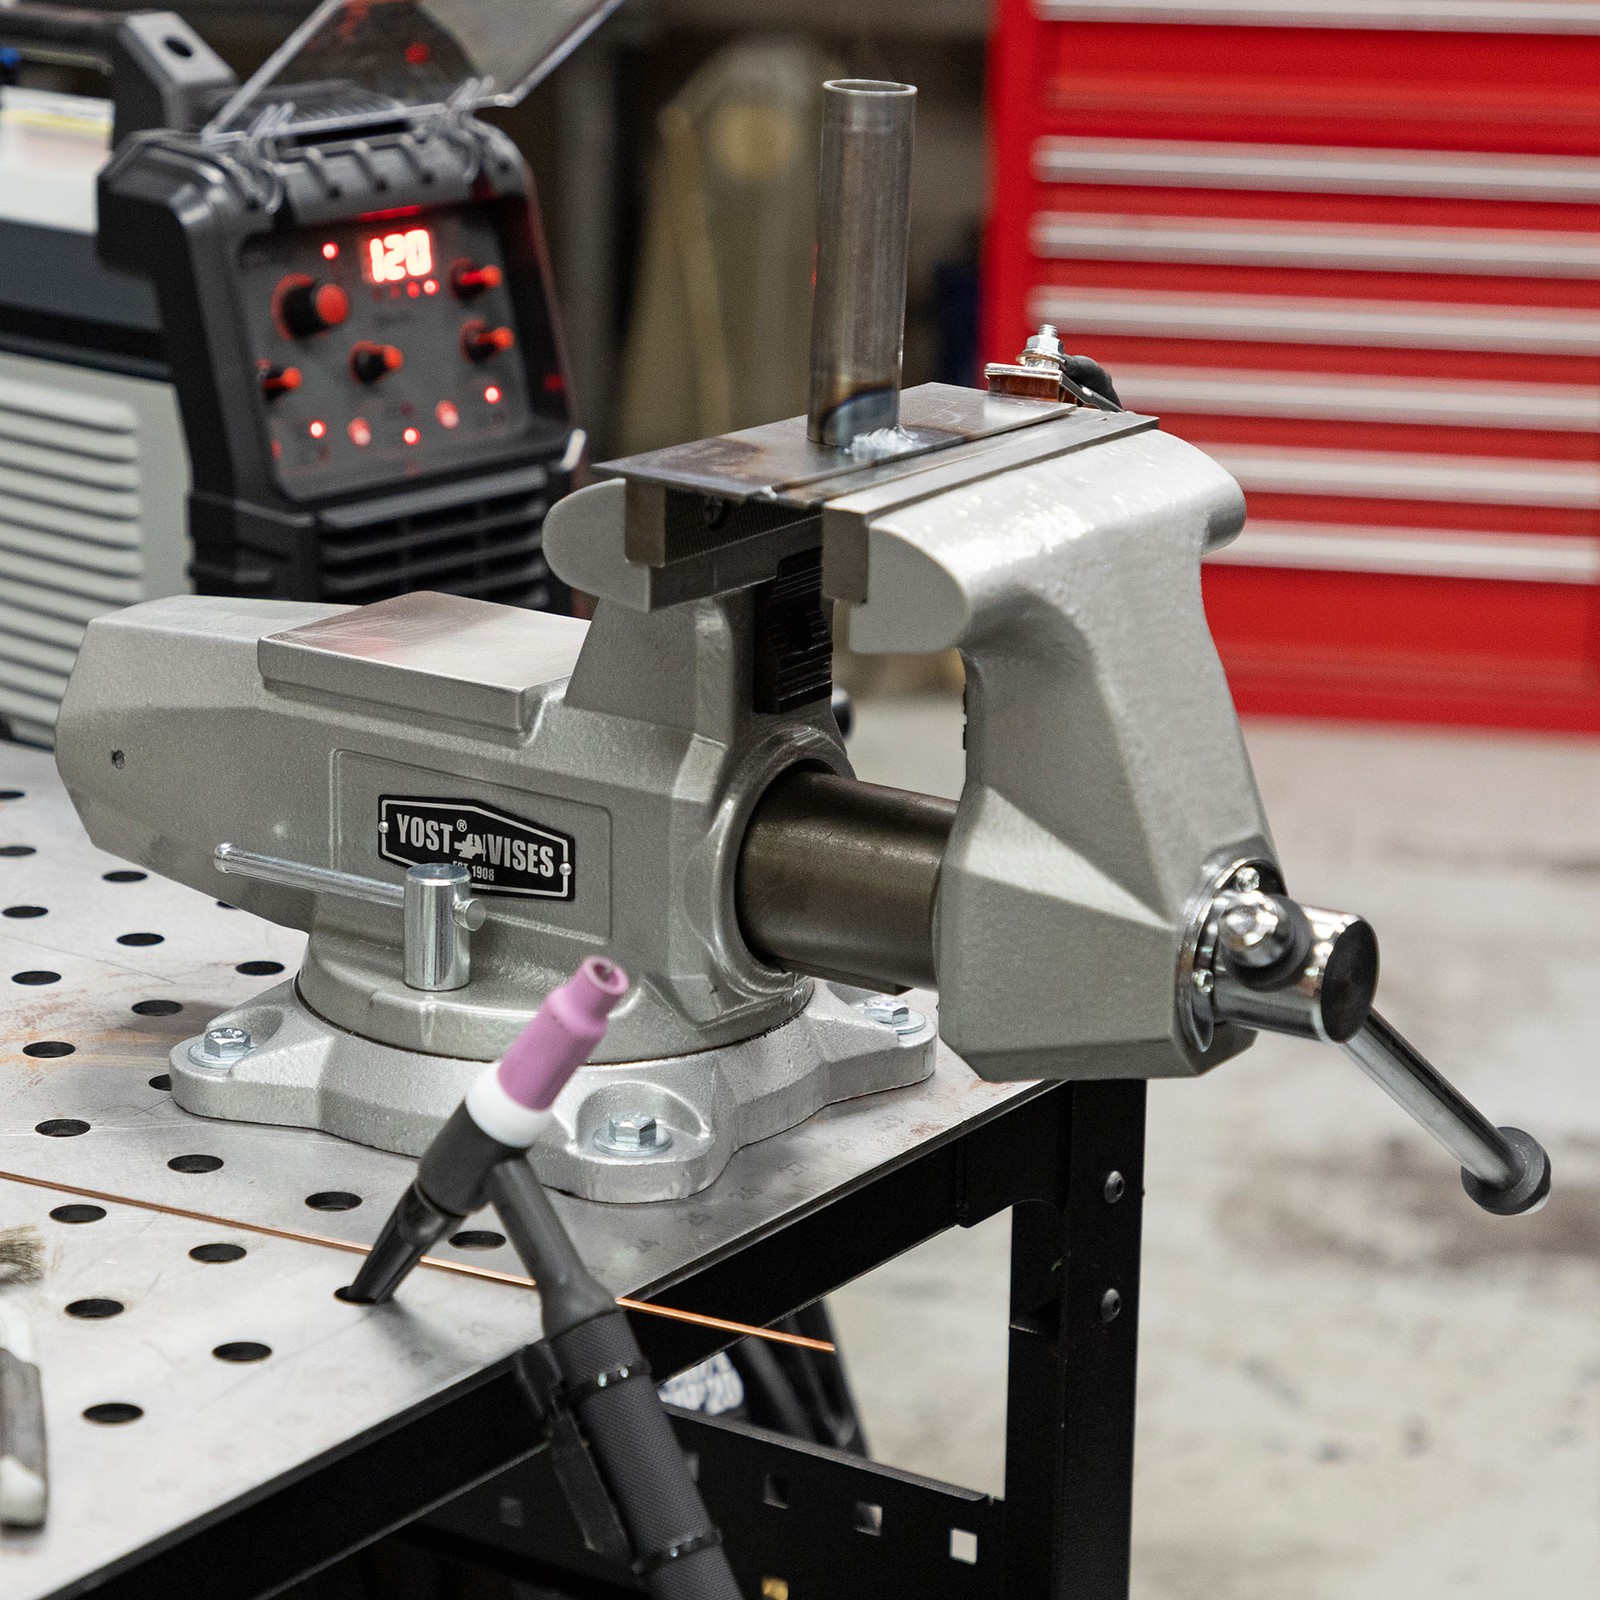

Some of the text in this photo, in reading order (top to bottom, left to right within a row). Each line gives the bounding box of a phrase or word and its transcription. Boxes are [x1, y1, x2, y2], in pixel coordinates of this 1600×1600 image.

[369, 228, 433, 283] 120
[472, 865, 495, 882] 1908
[487, 833, 554, 878] VISES
